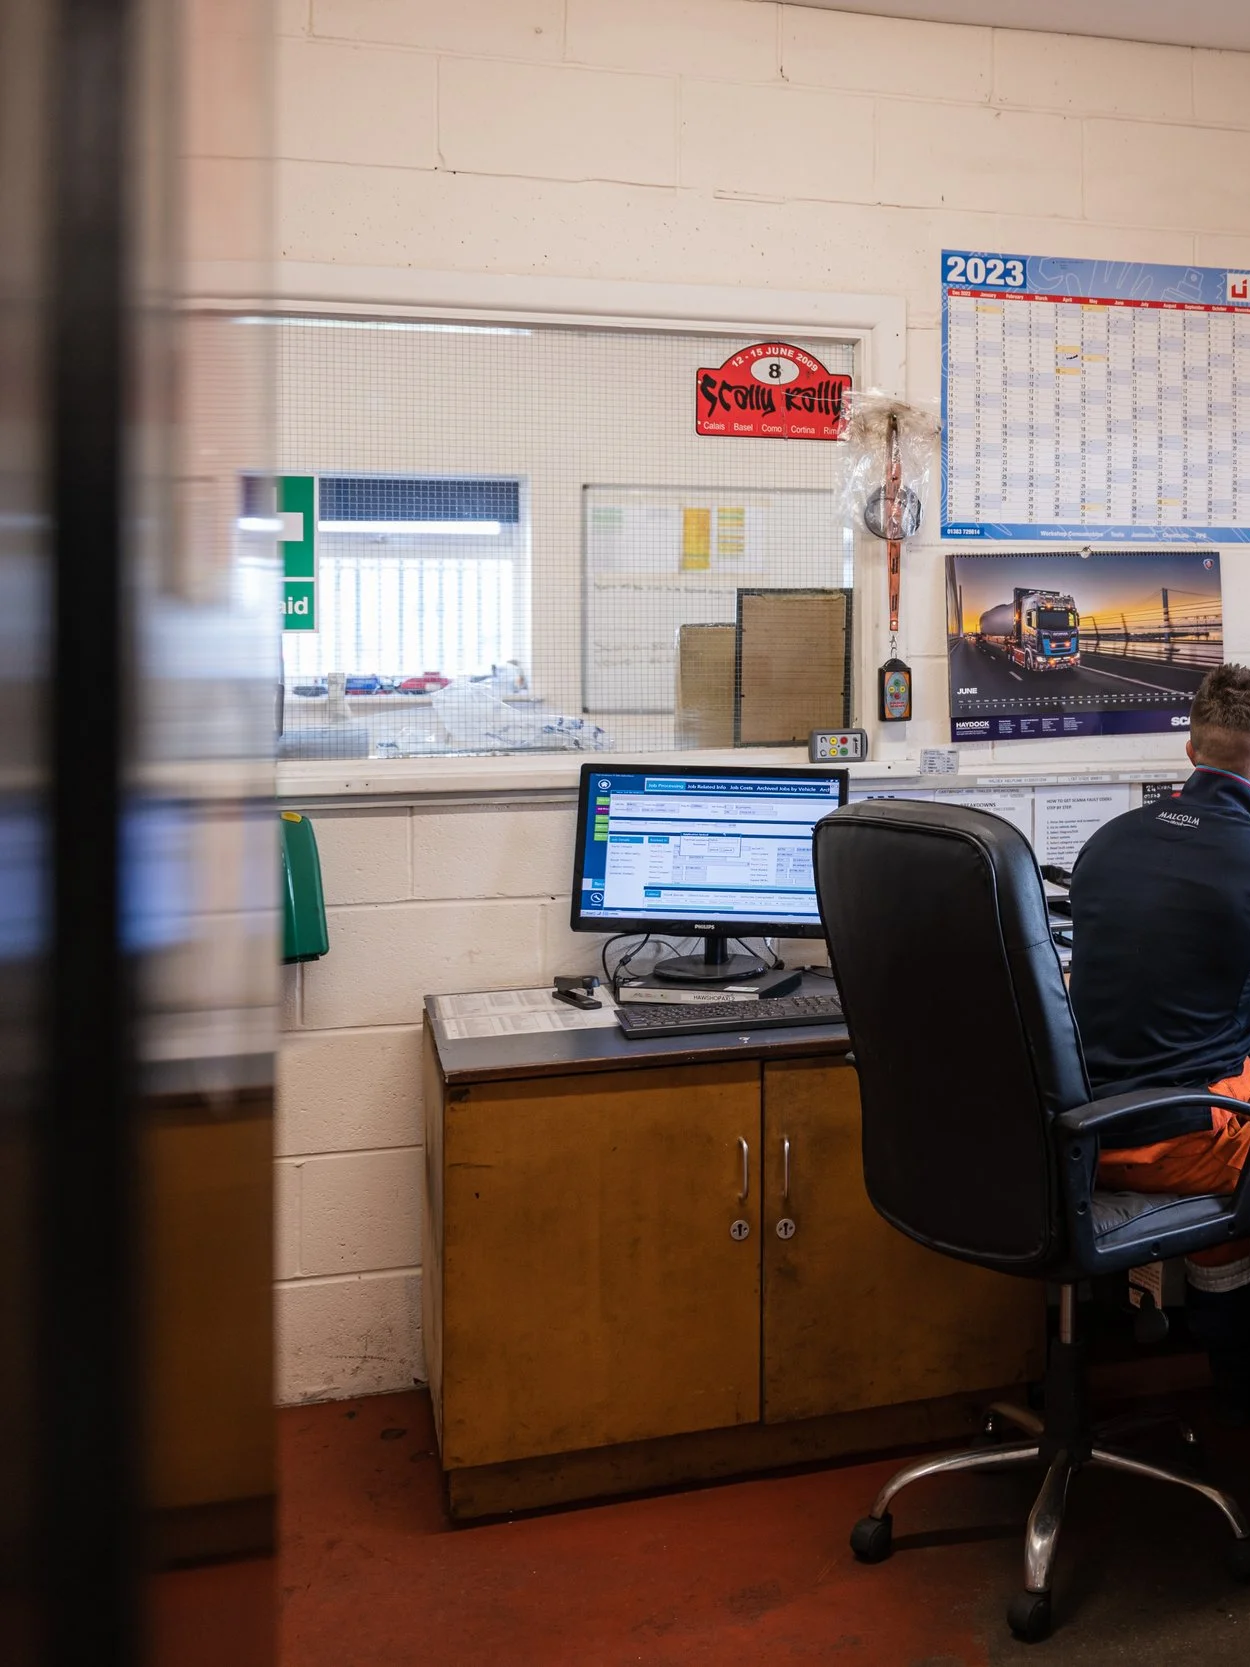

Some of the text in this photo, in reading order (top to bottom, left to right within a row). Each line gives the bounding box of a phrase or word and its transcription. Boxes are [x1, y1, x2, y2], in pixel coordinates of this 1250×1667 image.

[947, 256, 1024, 286] 2023
[732, 355, 744, 368] 12
[750, 347, 763, 357] 15
[766, 347, 794, 358] JUNE
[796, 351, 818, 372] 2009
[768, 364, 782, 379] 8
[704, 422, 725, 430] Calais
[734, 423, 753, 432] Basel
[762, 424, 782, 433] Como
[791, 425, 815, 434] Cortina
[279, 596, 308, 615] aid
[1158, 812, 1200, 826] MALCOLM
